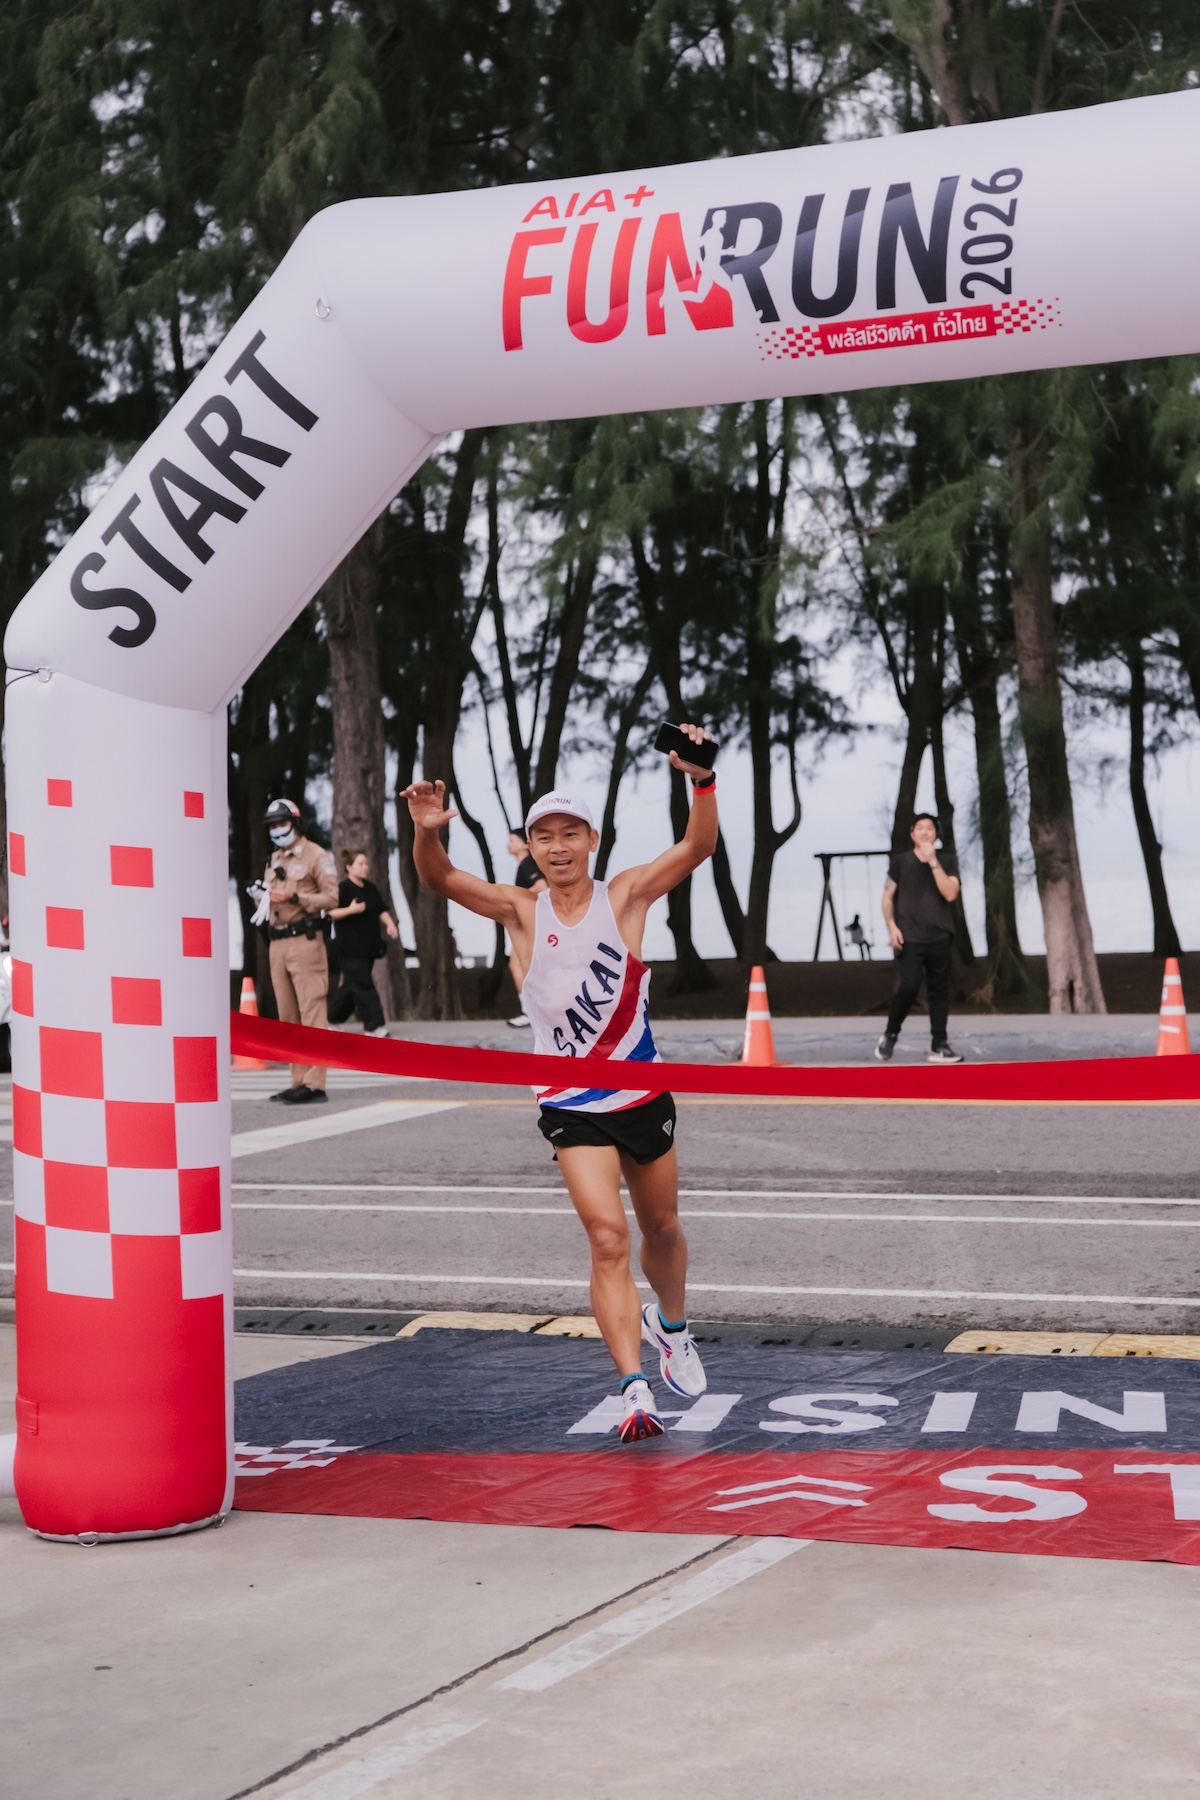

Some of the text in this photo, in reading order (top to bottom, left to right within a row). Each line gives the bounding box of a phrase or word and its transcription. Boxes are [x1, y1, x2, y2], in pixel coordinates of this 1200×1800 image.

[960, 168, 1023, 299] 2026
[933, 311, 987, 337] ทั่วไทย
[70, 329, 320, 648] START
[553, 942, 622, 1057] SAKAI
